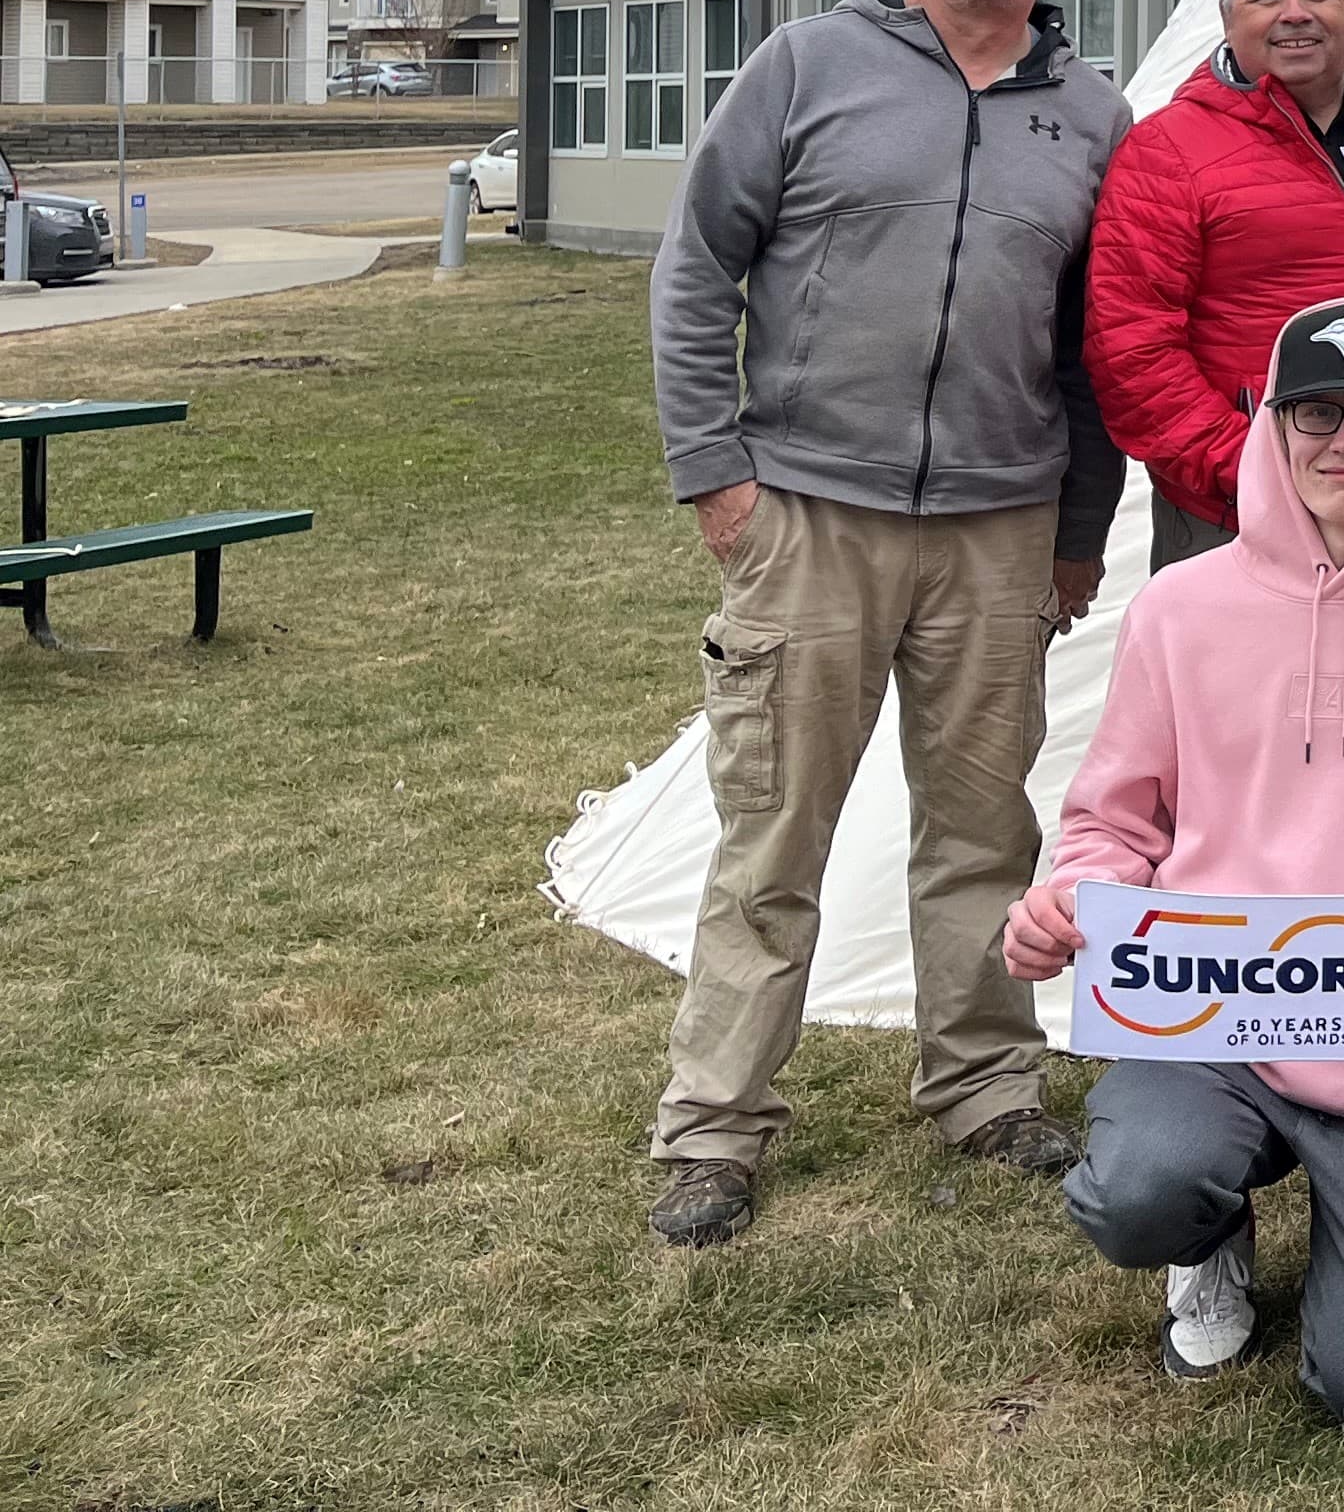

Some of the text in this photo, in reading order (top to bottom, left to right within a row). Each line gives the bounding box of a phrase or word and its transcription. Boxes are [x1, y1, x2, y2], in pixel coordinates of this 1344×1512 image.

[1236, 1017, 1342, 1033] 50 YEARS
[1226, 1033, 1249, 1046] OF
[1257, 1033, 1286, 1046] OIL
